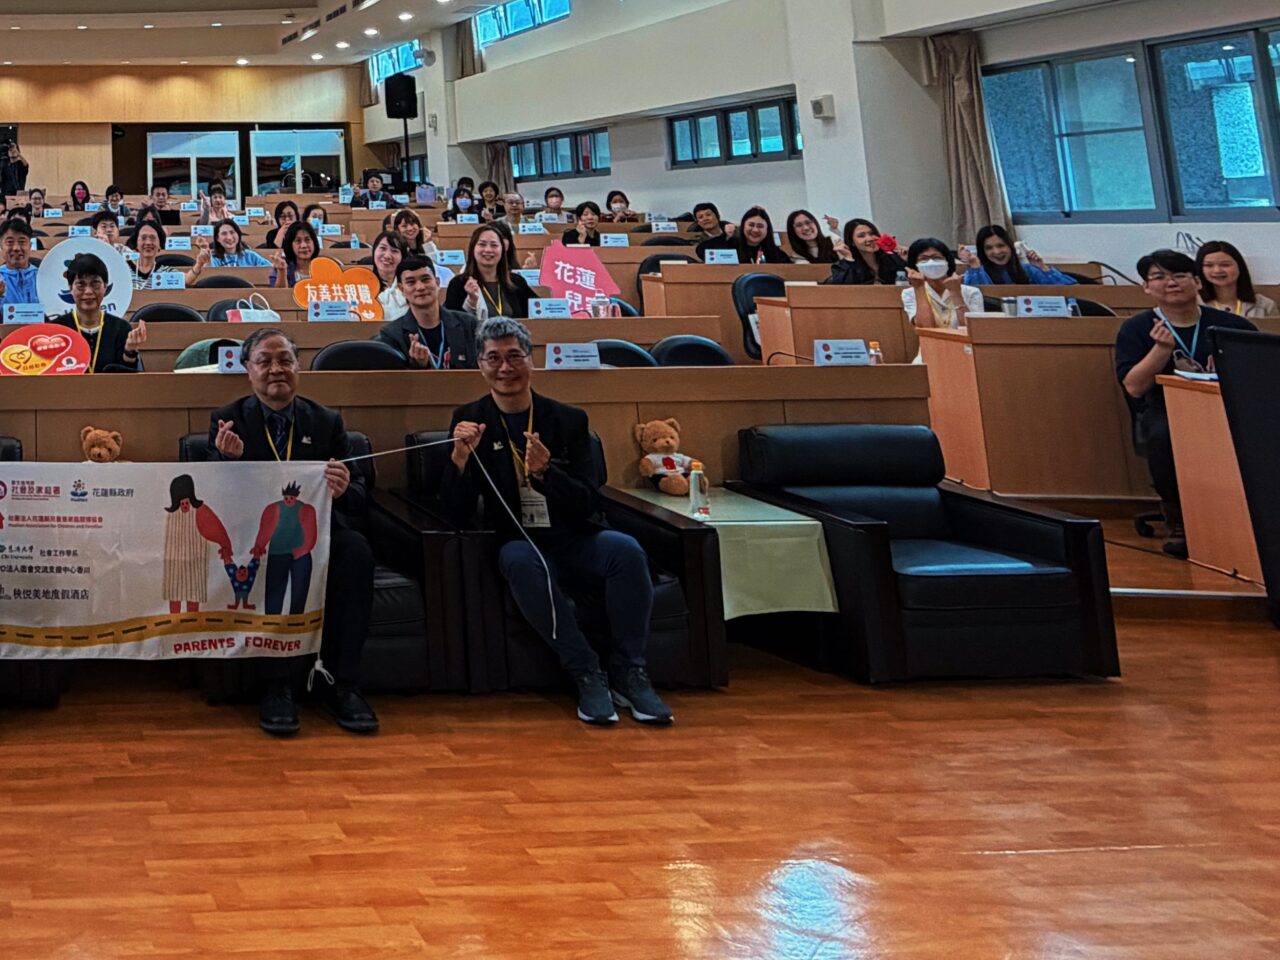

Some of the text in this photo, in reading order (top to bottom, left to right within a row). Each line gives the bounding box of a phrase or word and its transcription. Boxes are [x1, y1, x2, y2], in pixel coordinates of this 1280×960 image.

[554, 260, 596, 291] 花蓮
[304, 283, 373, 305] 友善共親職
[92, 488, 134, 498] 花蓮縣政府
[173, 636, 301, 654] PARENTS FOREVER
